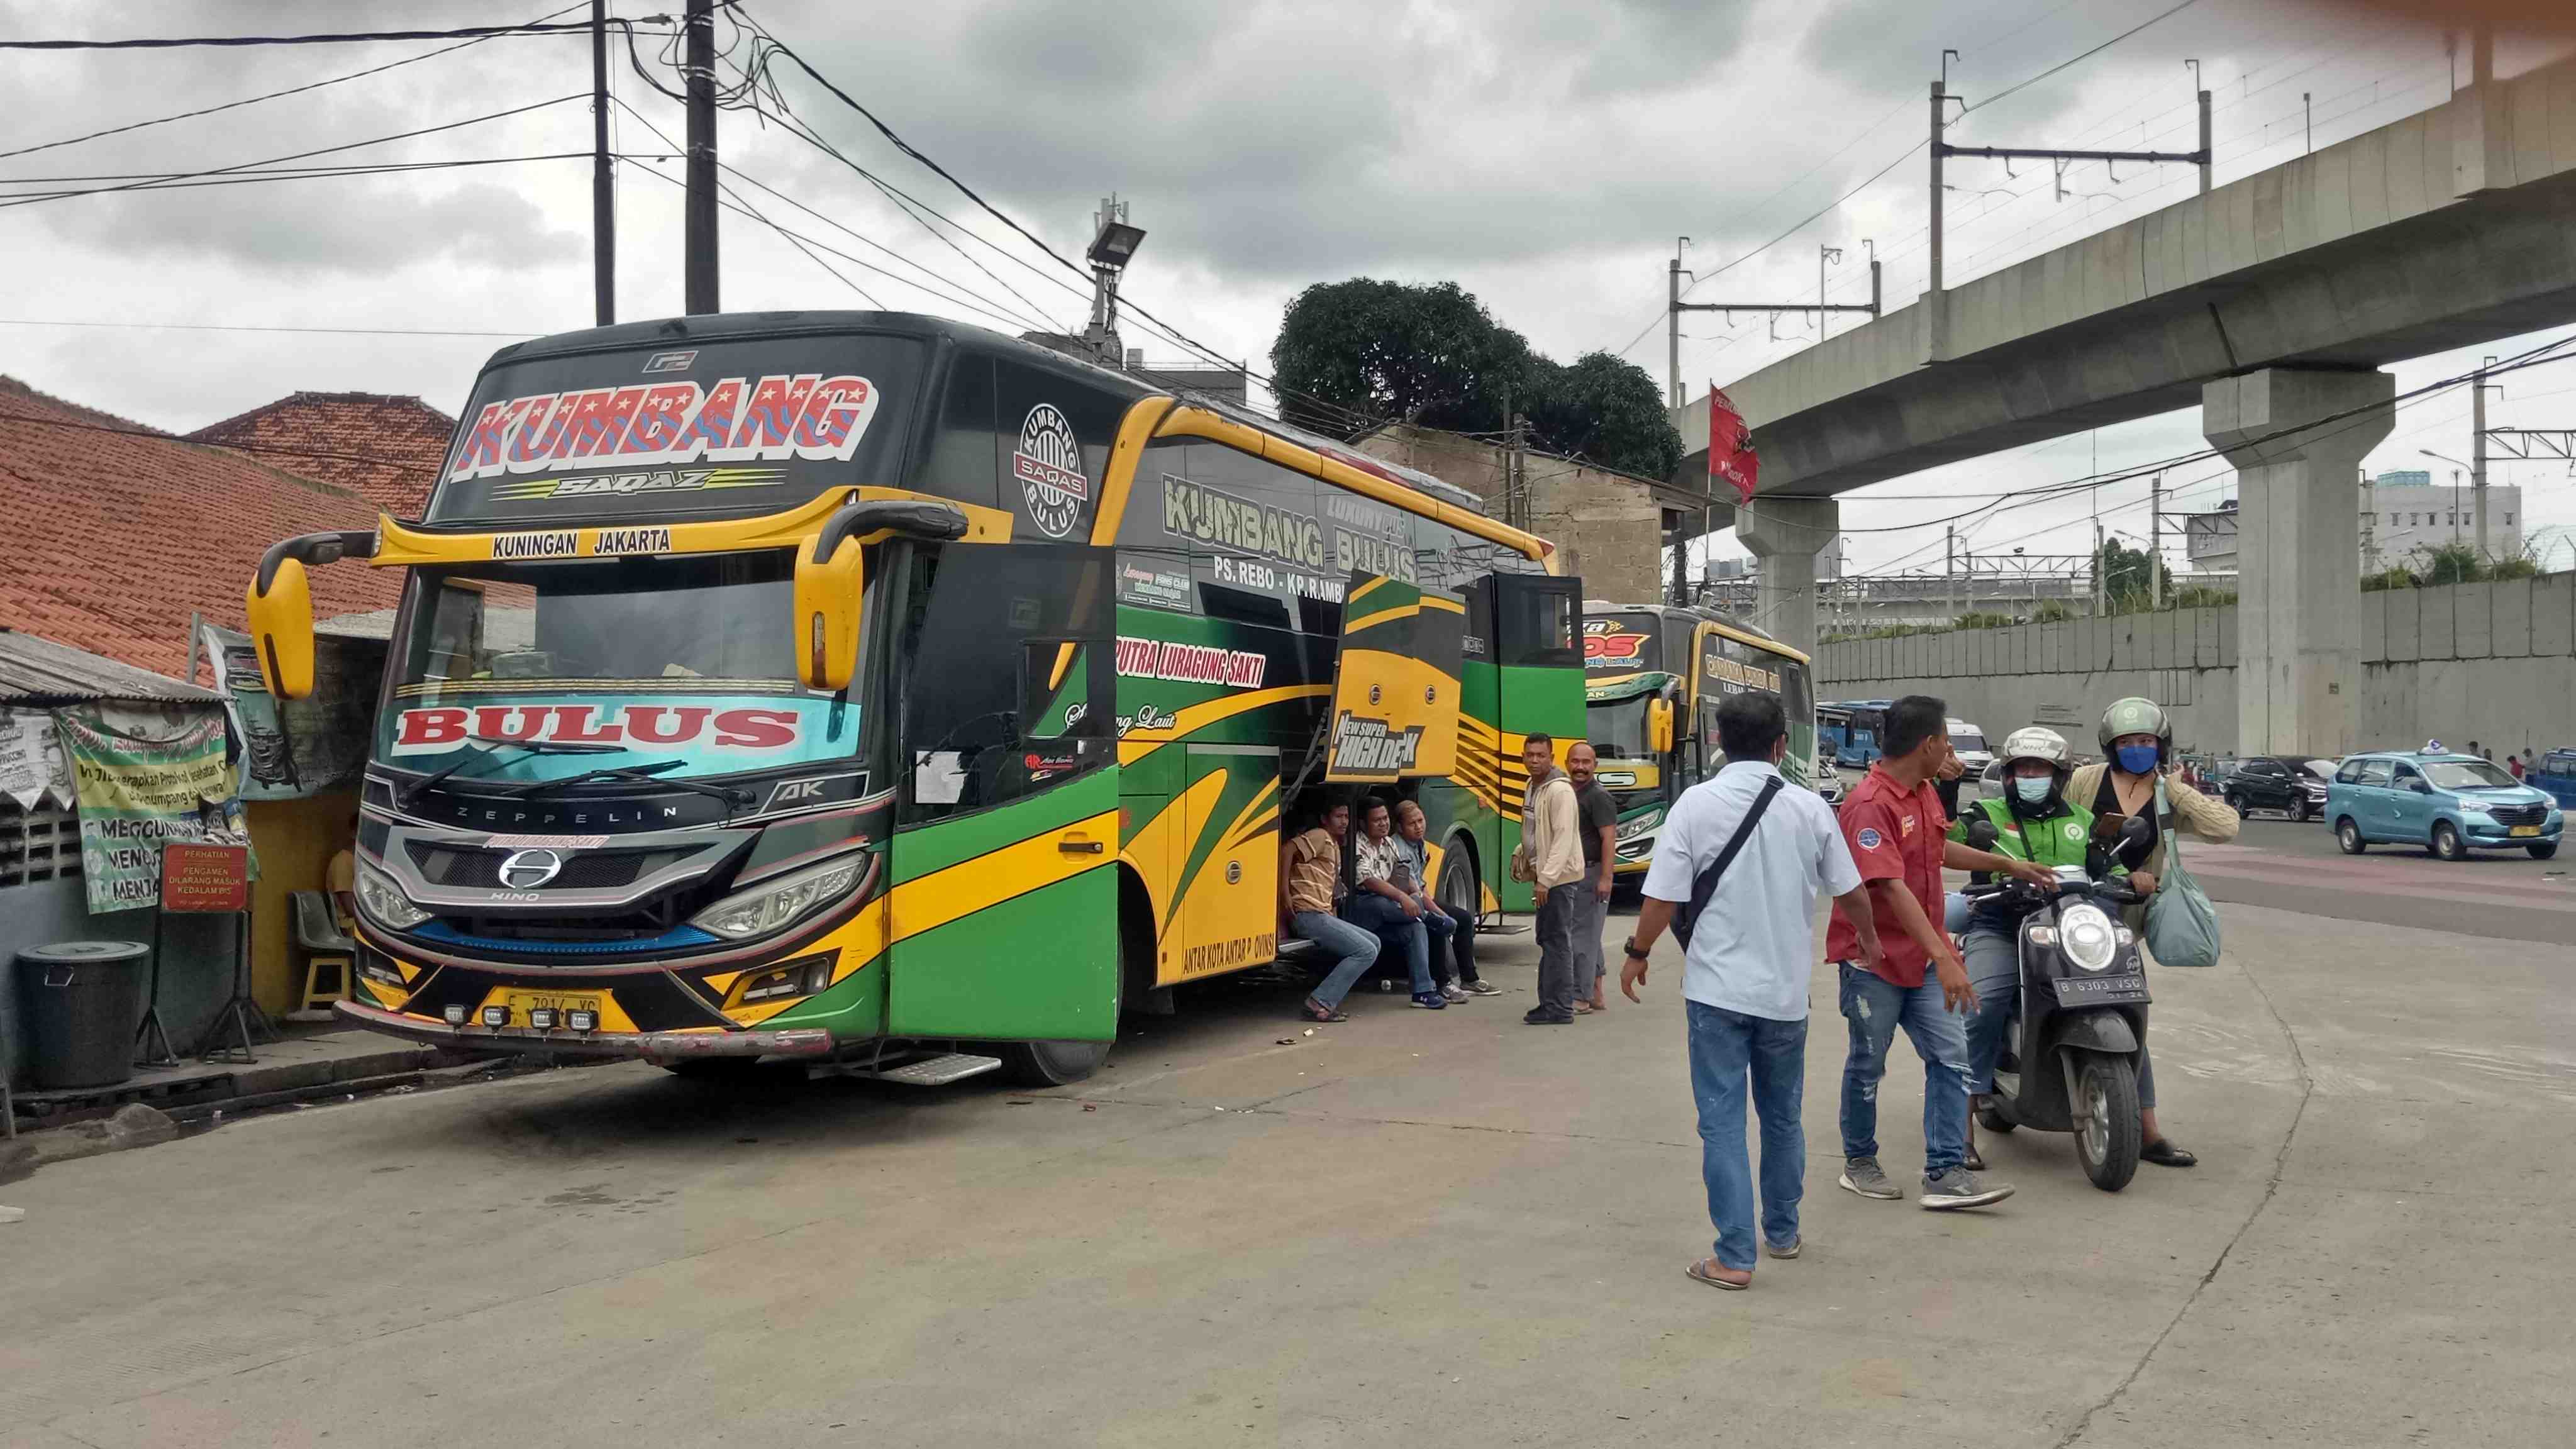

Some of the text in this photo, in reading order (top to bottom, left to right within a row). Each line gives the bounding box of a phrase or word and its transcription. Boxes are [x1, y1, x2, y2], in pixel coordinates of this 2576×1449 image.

[452, 374, 878, 482] KUMBANG
[1024, 409, 1076, 469] KUMBANG
[1021, 460, 1082, 492] SAQAS
[1026, 484, 1075, 531] BULUS
[1163, 476, 1325, 571] KUMBANG
[492, 527, 672, 559] KUNINGAN JAKARTA
[1334, 525, 1416, 586] BULUS
[1214, 555, 1236, 582] PS.
[1238, 562, 1274, 590] REBO
[1116, 636, 1266, 689] PUTRA LURAGUNG SAKTI
[392, 705, 798, 755] BULUS
[1136, 705, 1175, 730] Laut
[1334, 714, 1387, 744] NEW SUPER
[1335, 735, 1384, 768] HIGH
[457, 807, 676, 823] ZEPPELIN
[183, 867, 228, 875] PENGAMEN
[185, 850, 230, 858] PERHATIAN
[1184, 946, 1205, 975] ANTAR
[1207, 943, 1224, 969] KOTA
[1226, 938, 1246, 965] ANTAR
[2061, 982, 2070, 992] B
[2077, 980, 2109, 991] 6303
